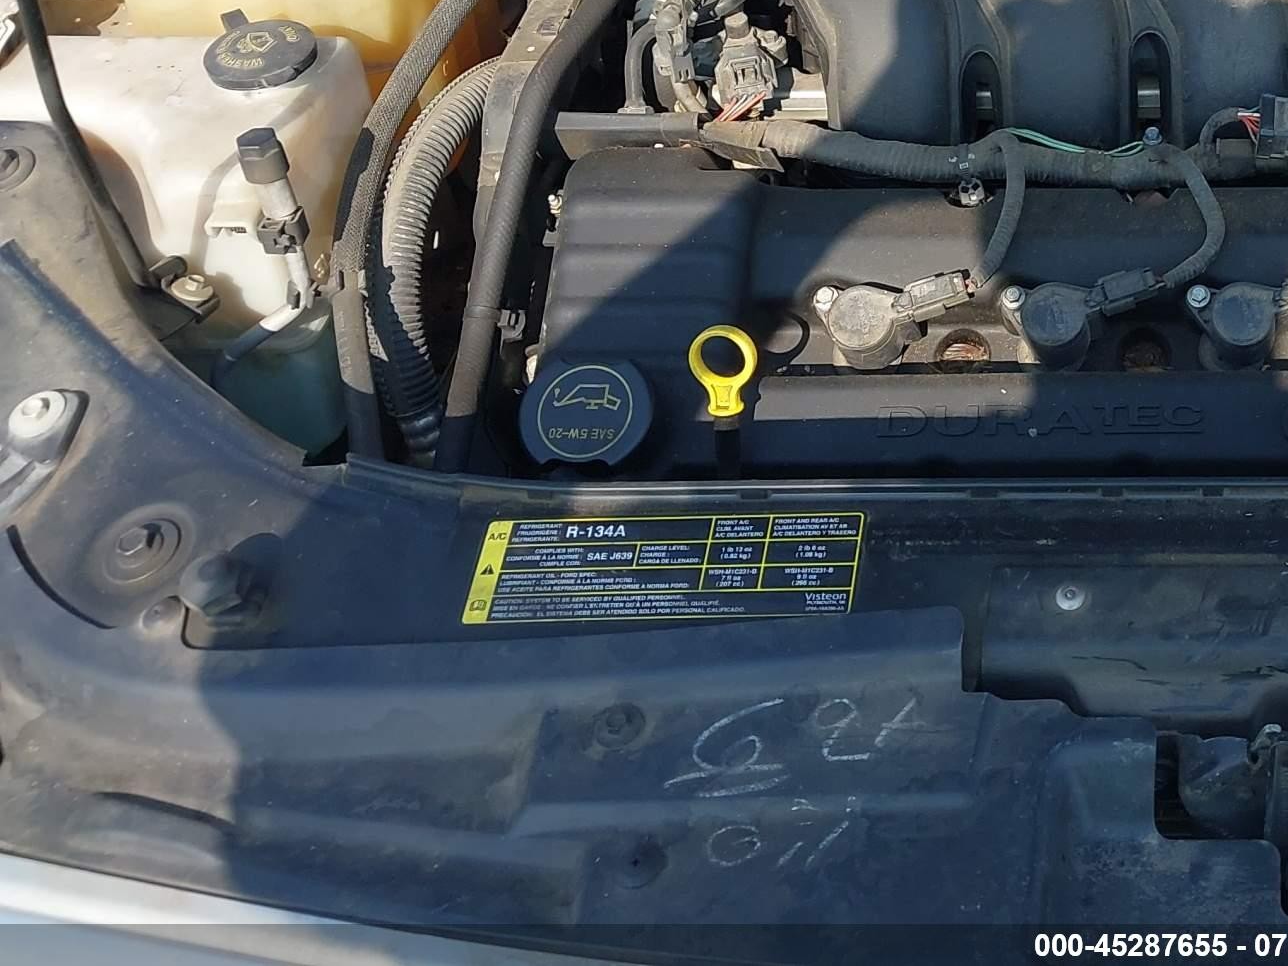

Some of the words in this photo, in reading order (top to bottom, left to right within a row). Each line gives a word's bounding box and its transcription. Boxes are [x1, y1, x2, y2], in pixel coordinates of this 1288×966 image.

[218, 51, 265, 68] WASHER
[874, 403, 1205, 438] DURATEC
[548, 428, 589, 440] 5W-20
[590, 428, 616, 440] SAE
[487, 532, 506, 540] A/C
[565, 524, 627, 538] R-134A
[586, 552, 608, 560] SAE
[608, 552, 632, 560] J639
[804, 591, 847, 600] Visteon
